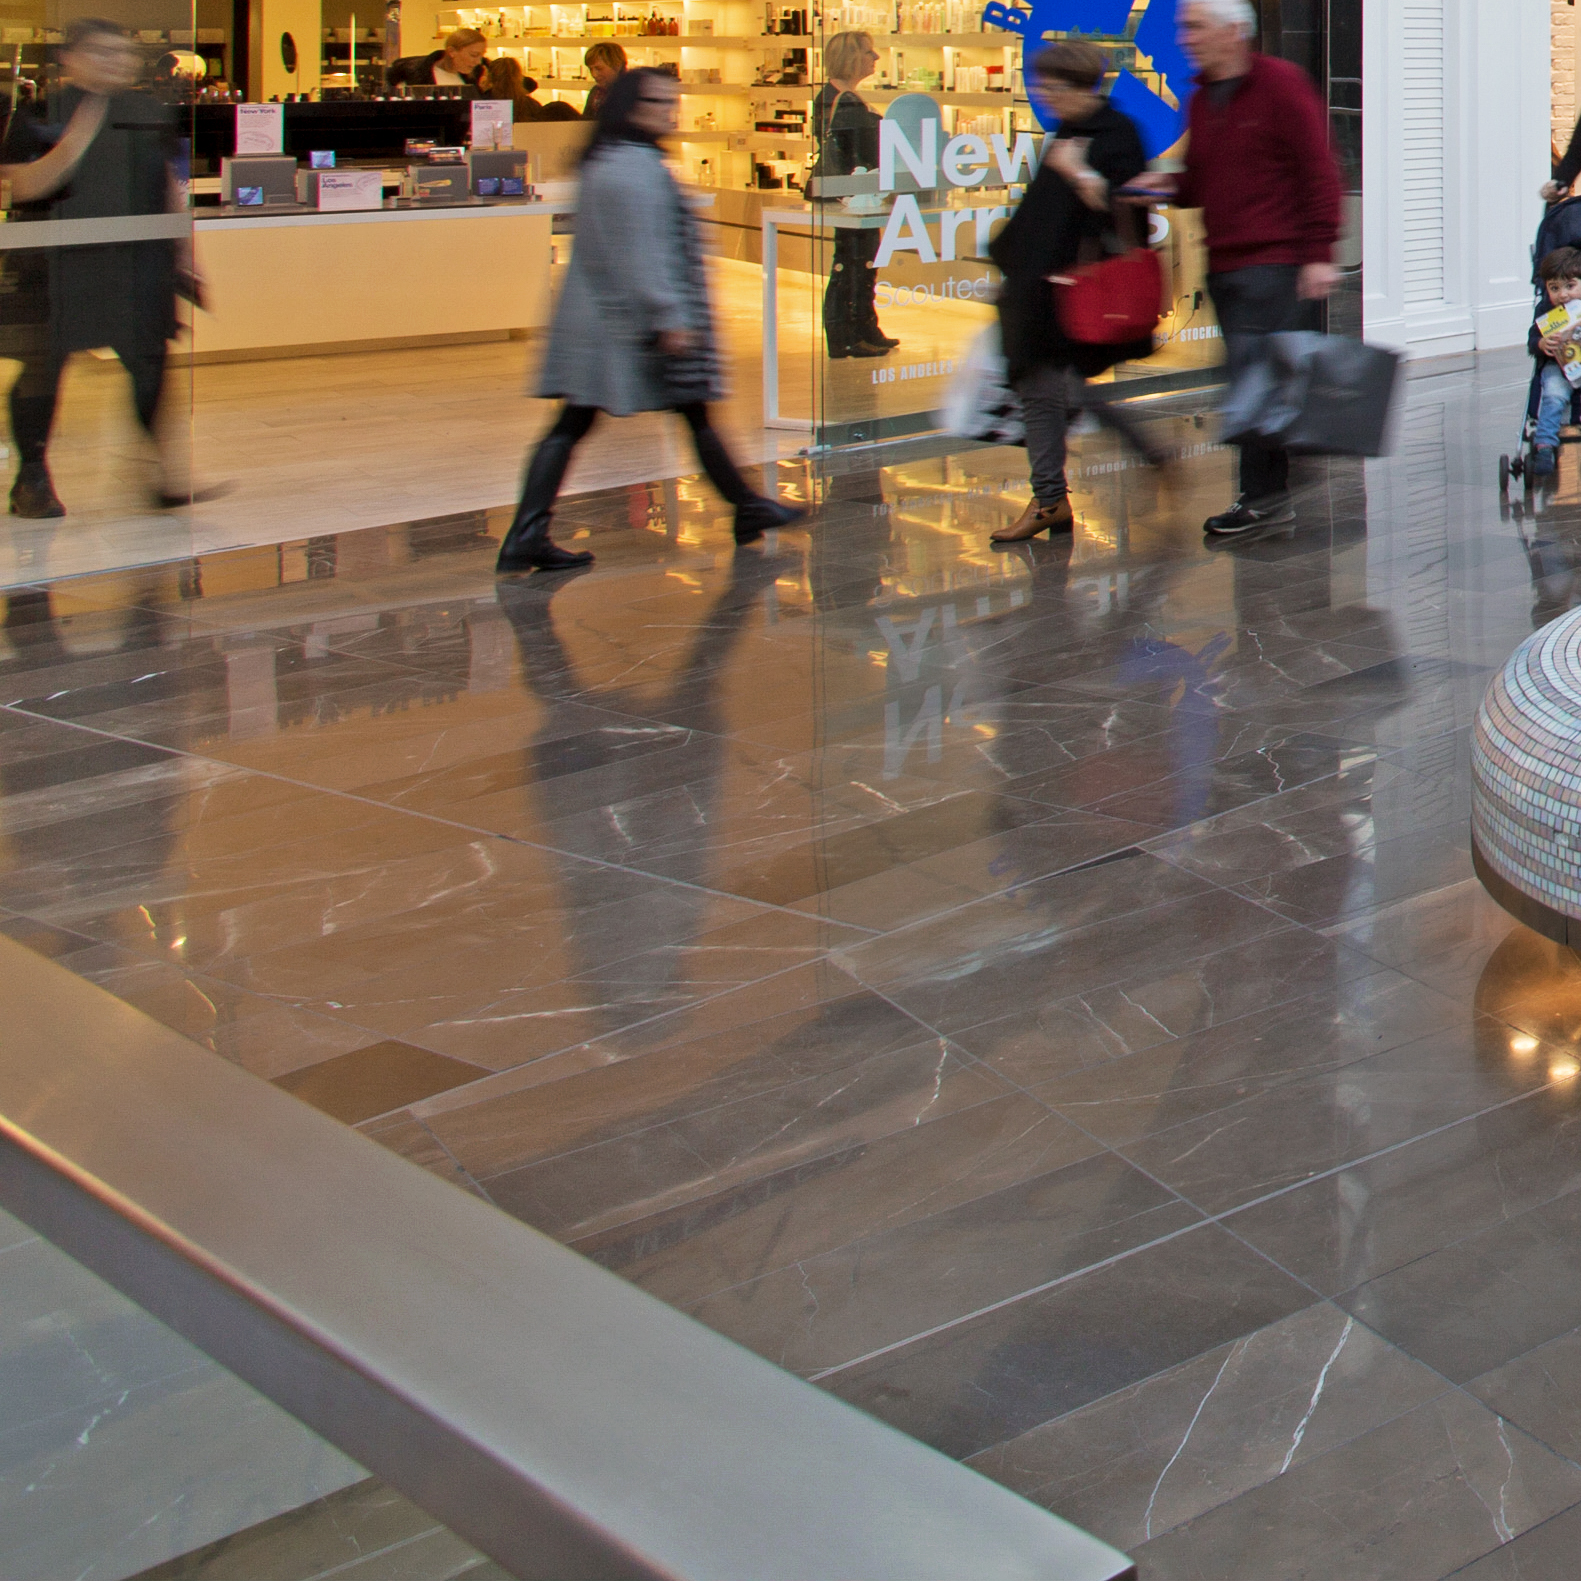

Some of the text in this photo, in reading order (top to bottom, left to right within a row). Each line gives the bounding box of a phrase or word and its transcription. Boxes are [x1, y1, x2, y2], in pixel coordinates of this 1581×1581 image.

[879, 118, 1057, 191] New
[873, 271, 990, 309] Scouted
[872, 360, 954, 385] LOS ANGELES
